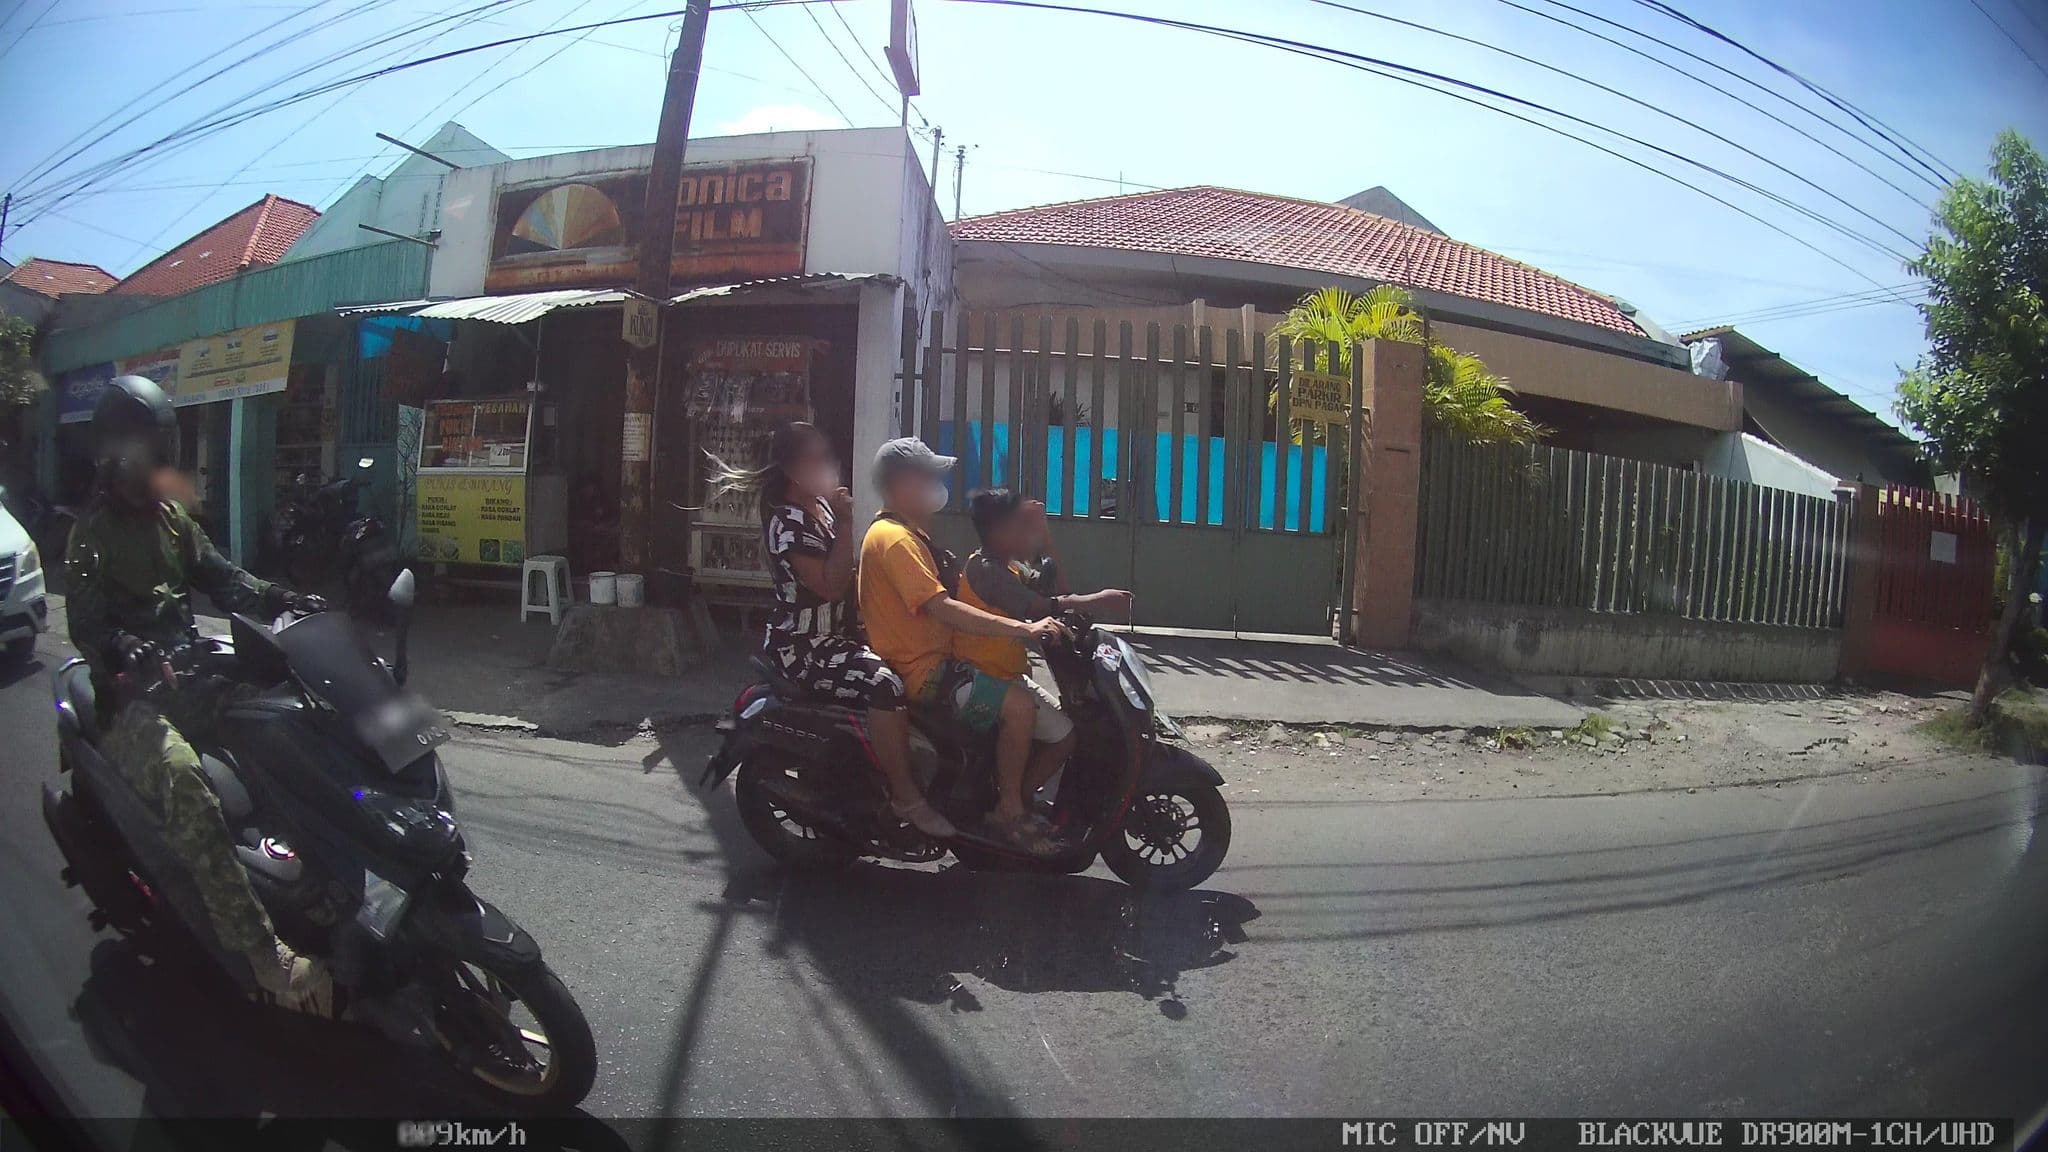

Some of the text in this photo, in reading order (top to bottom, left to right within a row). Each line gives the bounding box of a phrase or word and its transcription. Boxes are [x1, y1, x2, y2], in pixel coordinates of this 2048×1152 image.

[678, 164, 793, 206] onica
[766, 342, 801, 359] SERVIS
[1297, 387, 1342, 403] PARKIR
